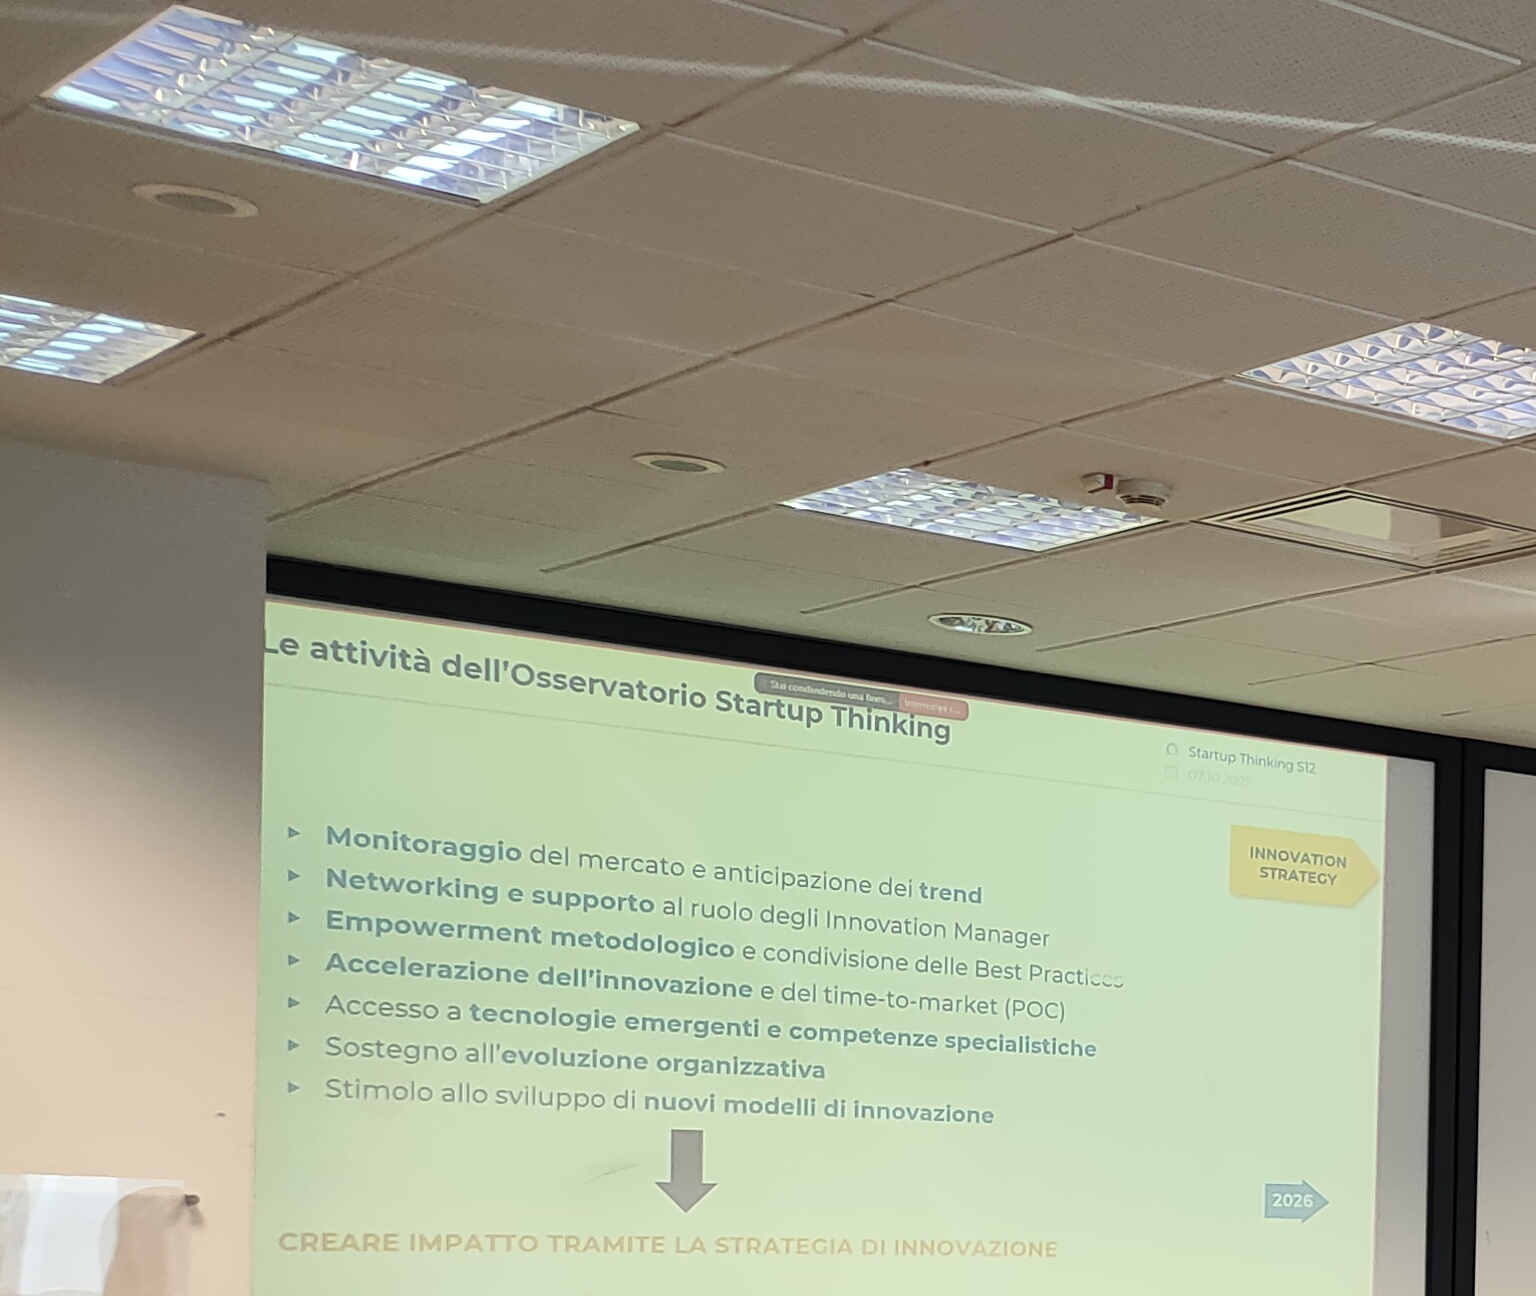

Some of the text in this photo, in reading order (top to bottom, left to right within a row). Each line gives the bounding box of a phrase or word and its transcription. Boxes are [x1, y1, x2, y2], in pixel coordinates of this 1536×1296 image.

[309, 639, 432, 675] attività
[715, 690, 824, 728] Startup
[831, 704, 951, 745] Thinking
[1188, 745, 1317, 775] Startup Thinking S12
[326, 825, 982, 905] Monitoraggio del mercato e anticipazione dei trend
[1249, 845, 1347, 869] INNOVATION
[1259, 865, 1338, 886] STRATEGY
[326, 867, 1051, 950] Networking e supporto al ruolo degli Innovation Manager
[326, 909, 543, 945] Empowerment
[550, 930, 735, 960] metodologico
[742, 944, 757, 961] e
[762, 945, 909, 972] condivisione
[914, 954, 969, 977] delle
[975, 959, 1023, 981] Best
[324, 952, 530, 984] Accelerazione
[760, 985, 775, 1001] e
[780, 981, 817, 1004] del
[822, 984, 999, 1016] time-to-market
[1004, 996, 1065, 1025] (POC)
[324, 993, 1097, 1058] Accesso a tecnologie emergenti e competenze specialistiche
[324, 1036, 458, 1065] Sostegno
[656, 1055, 826, 1080] organizzativa
[324, 1077, 995, 1125] Stimolo allo sviluppo di nuovi modelli di innovazione
[1272, 1192, 1313, 1208] 2026
[277, 1231, 1059, 1259] CREARE IMPATTO TRAMITE LA STRATEGIA DI INNOVAZIONE
